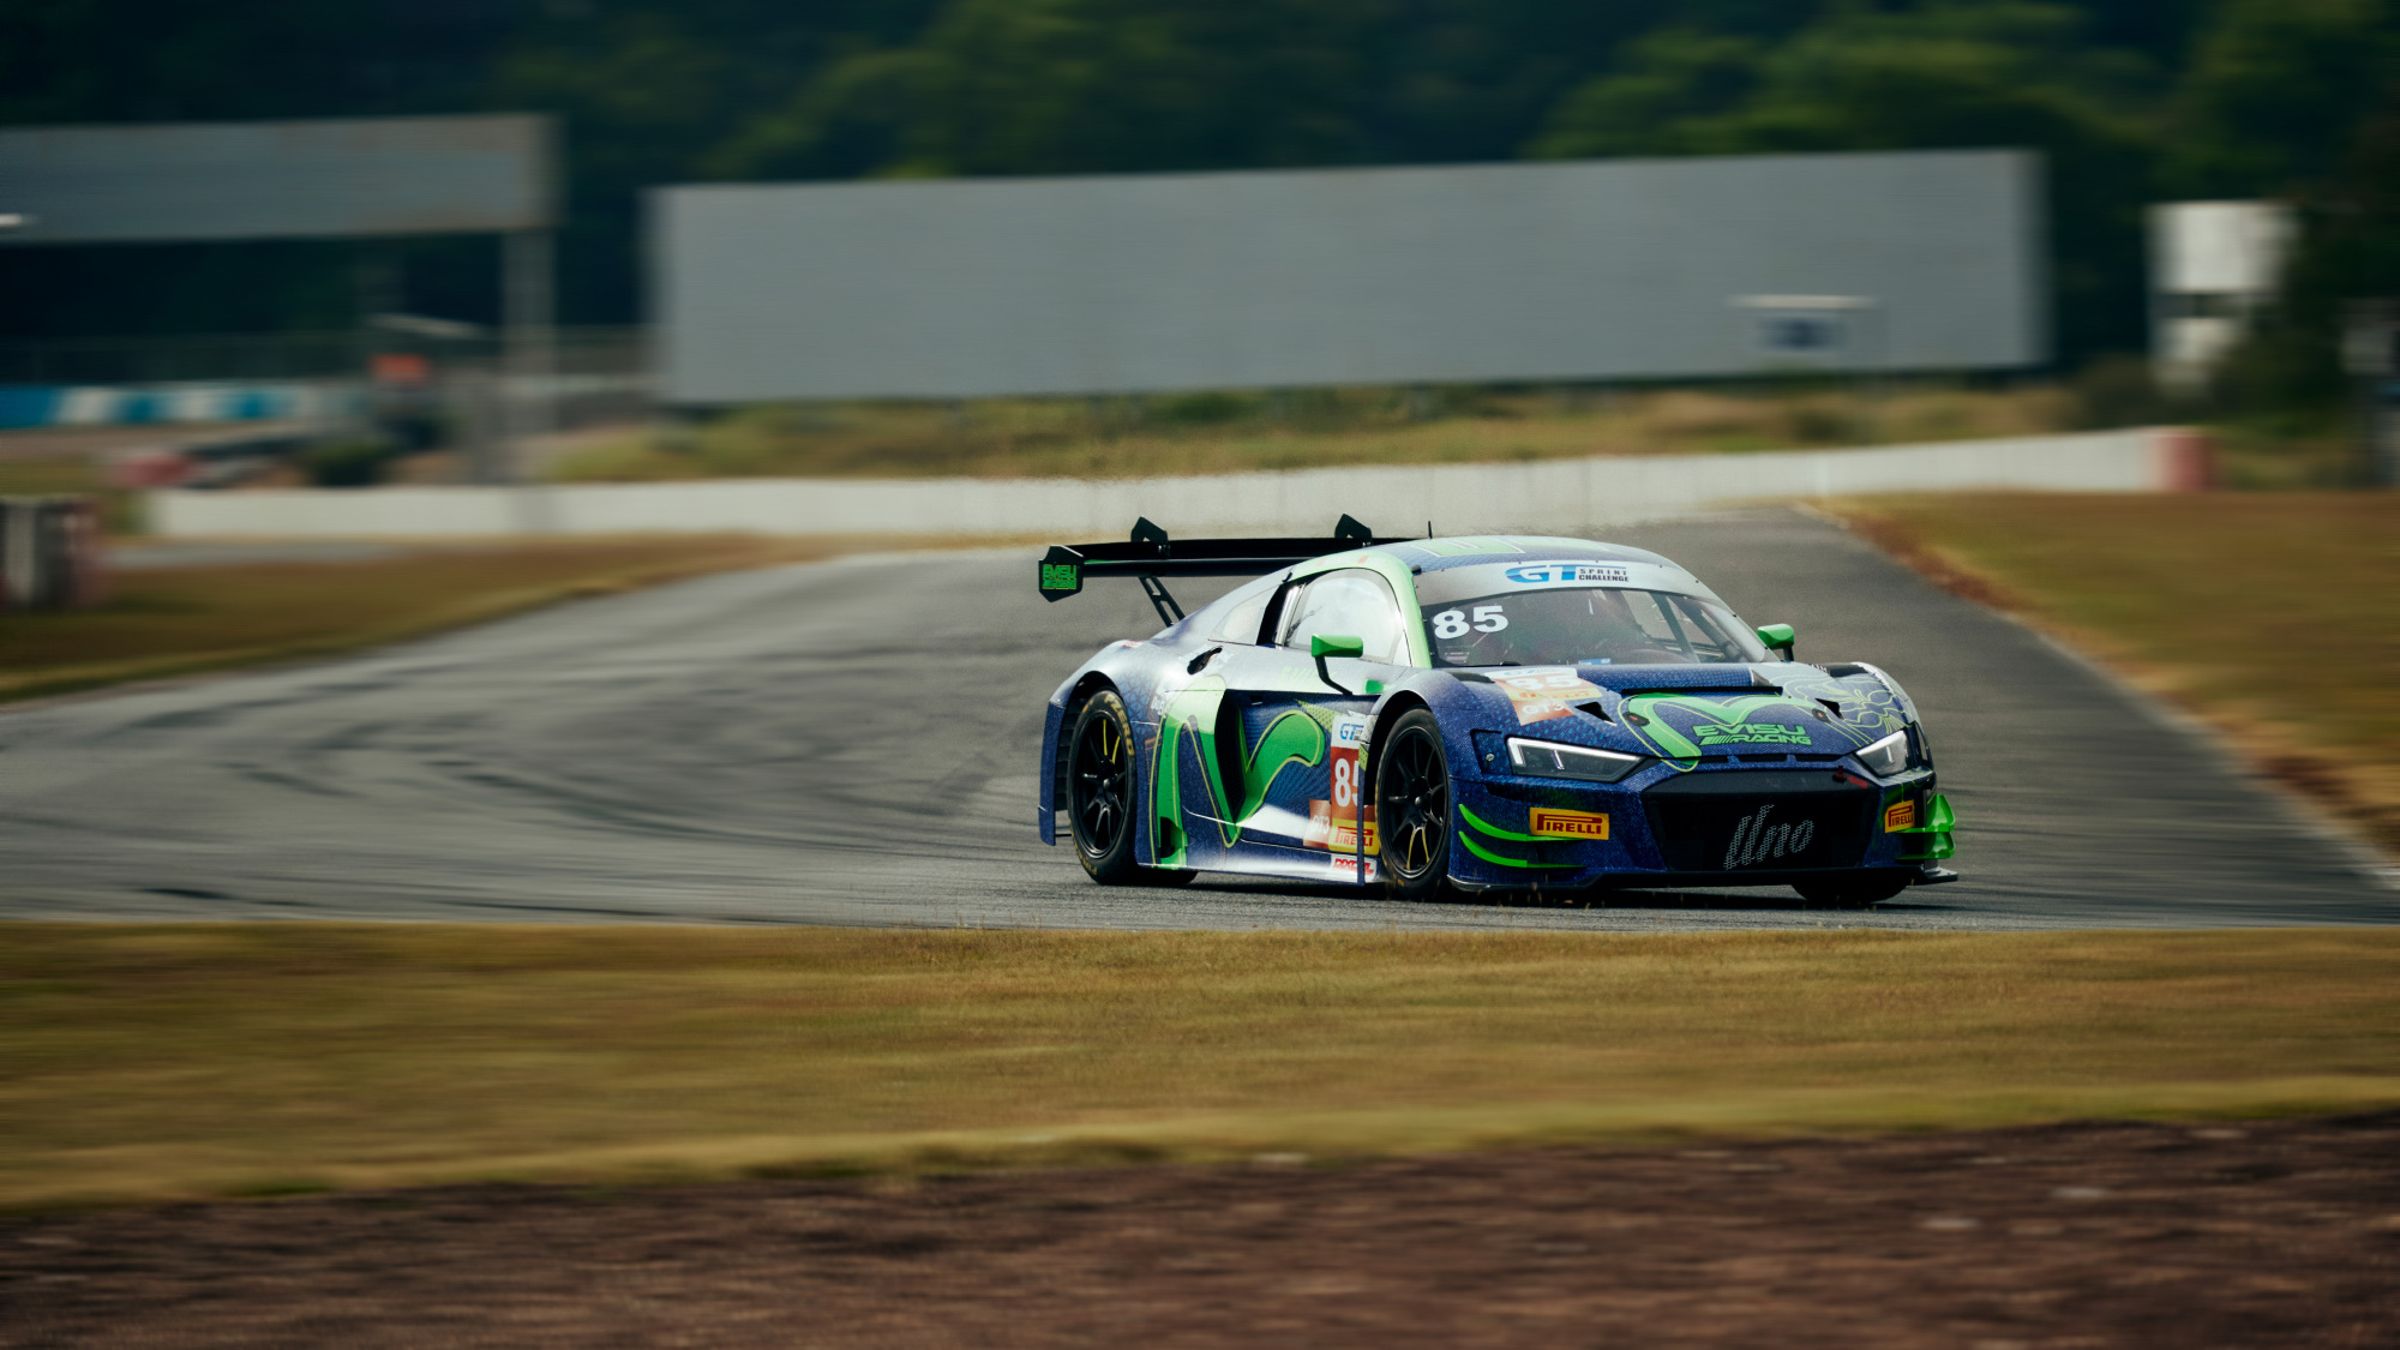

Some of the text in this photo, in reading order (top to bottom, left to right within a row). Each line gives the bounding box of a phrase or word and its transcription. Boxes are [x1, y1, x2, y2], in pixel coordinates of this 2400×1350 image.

[1504, 564, 1577, 583] GT
[1579, 573, 1629, 582] CHALLENGE
[1580, 568, 1627, 576] SPRINT
[1433, 605, 1509, 640] 85
[1692, 724, 1806, 737] EVISU
[1728, 734, 1812, 746] RACING
[1536, 813, 1603, 834] PIRELLI
[1335, 826, 1374, 847] PIRELI
